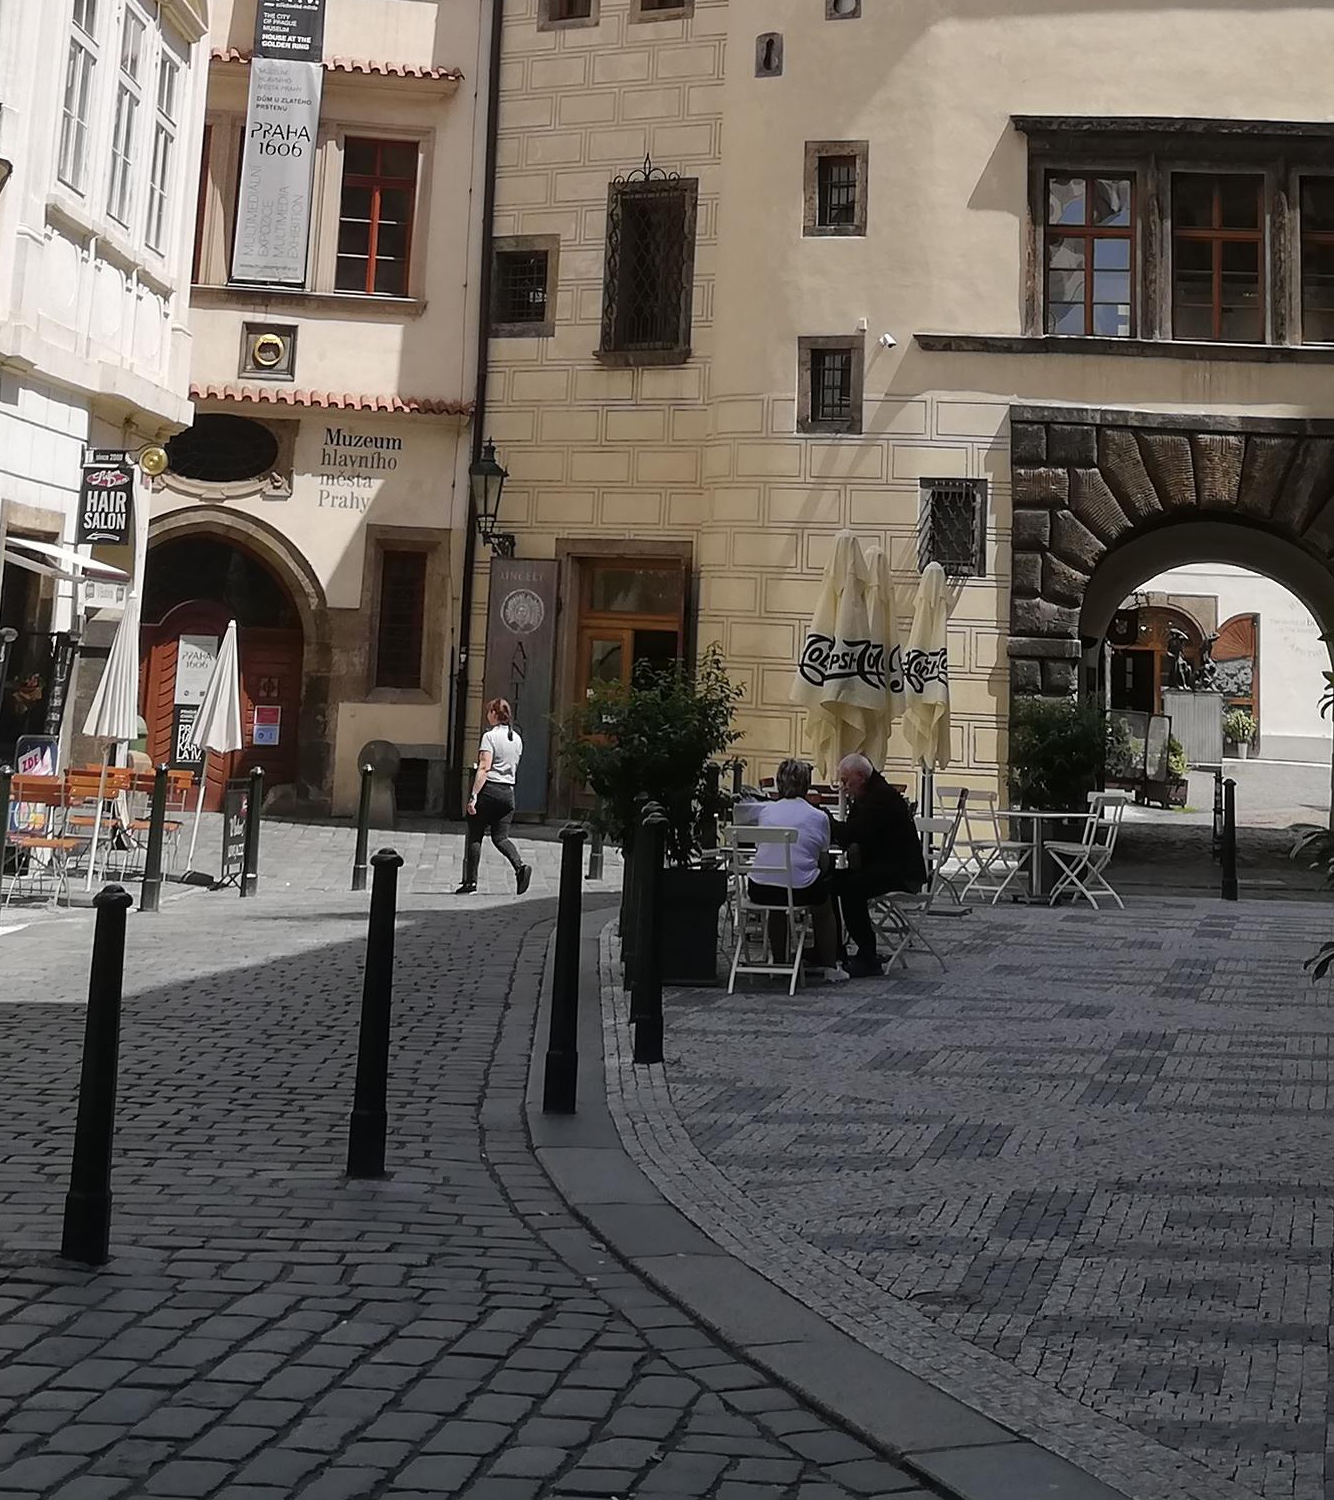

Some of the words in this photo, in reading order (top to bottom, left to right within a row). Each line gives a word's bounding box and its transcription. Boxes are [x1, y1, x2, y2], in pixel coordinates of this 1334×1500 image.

[256, 94, 273, 102] DŮM
[280, 97, 312, 106] ZLATÉHO
[250, 121, 311, 143] PRAHA
[259, 138, 303, 158] 1606
[324, 427, 402, 450] Muzeum
[320, 448, 397, 470] hlavního
[319, 469, 373, 489] města
[86, 490, 128, 513] HAIR
[318, 489, 370, 514] Prahy
[83, 512, 127, 530] SALON
